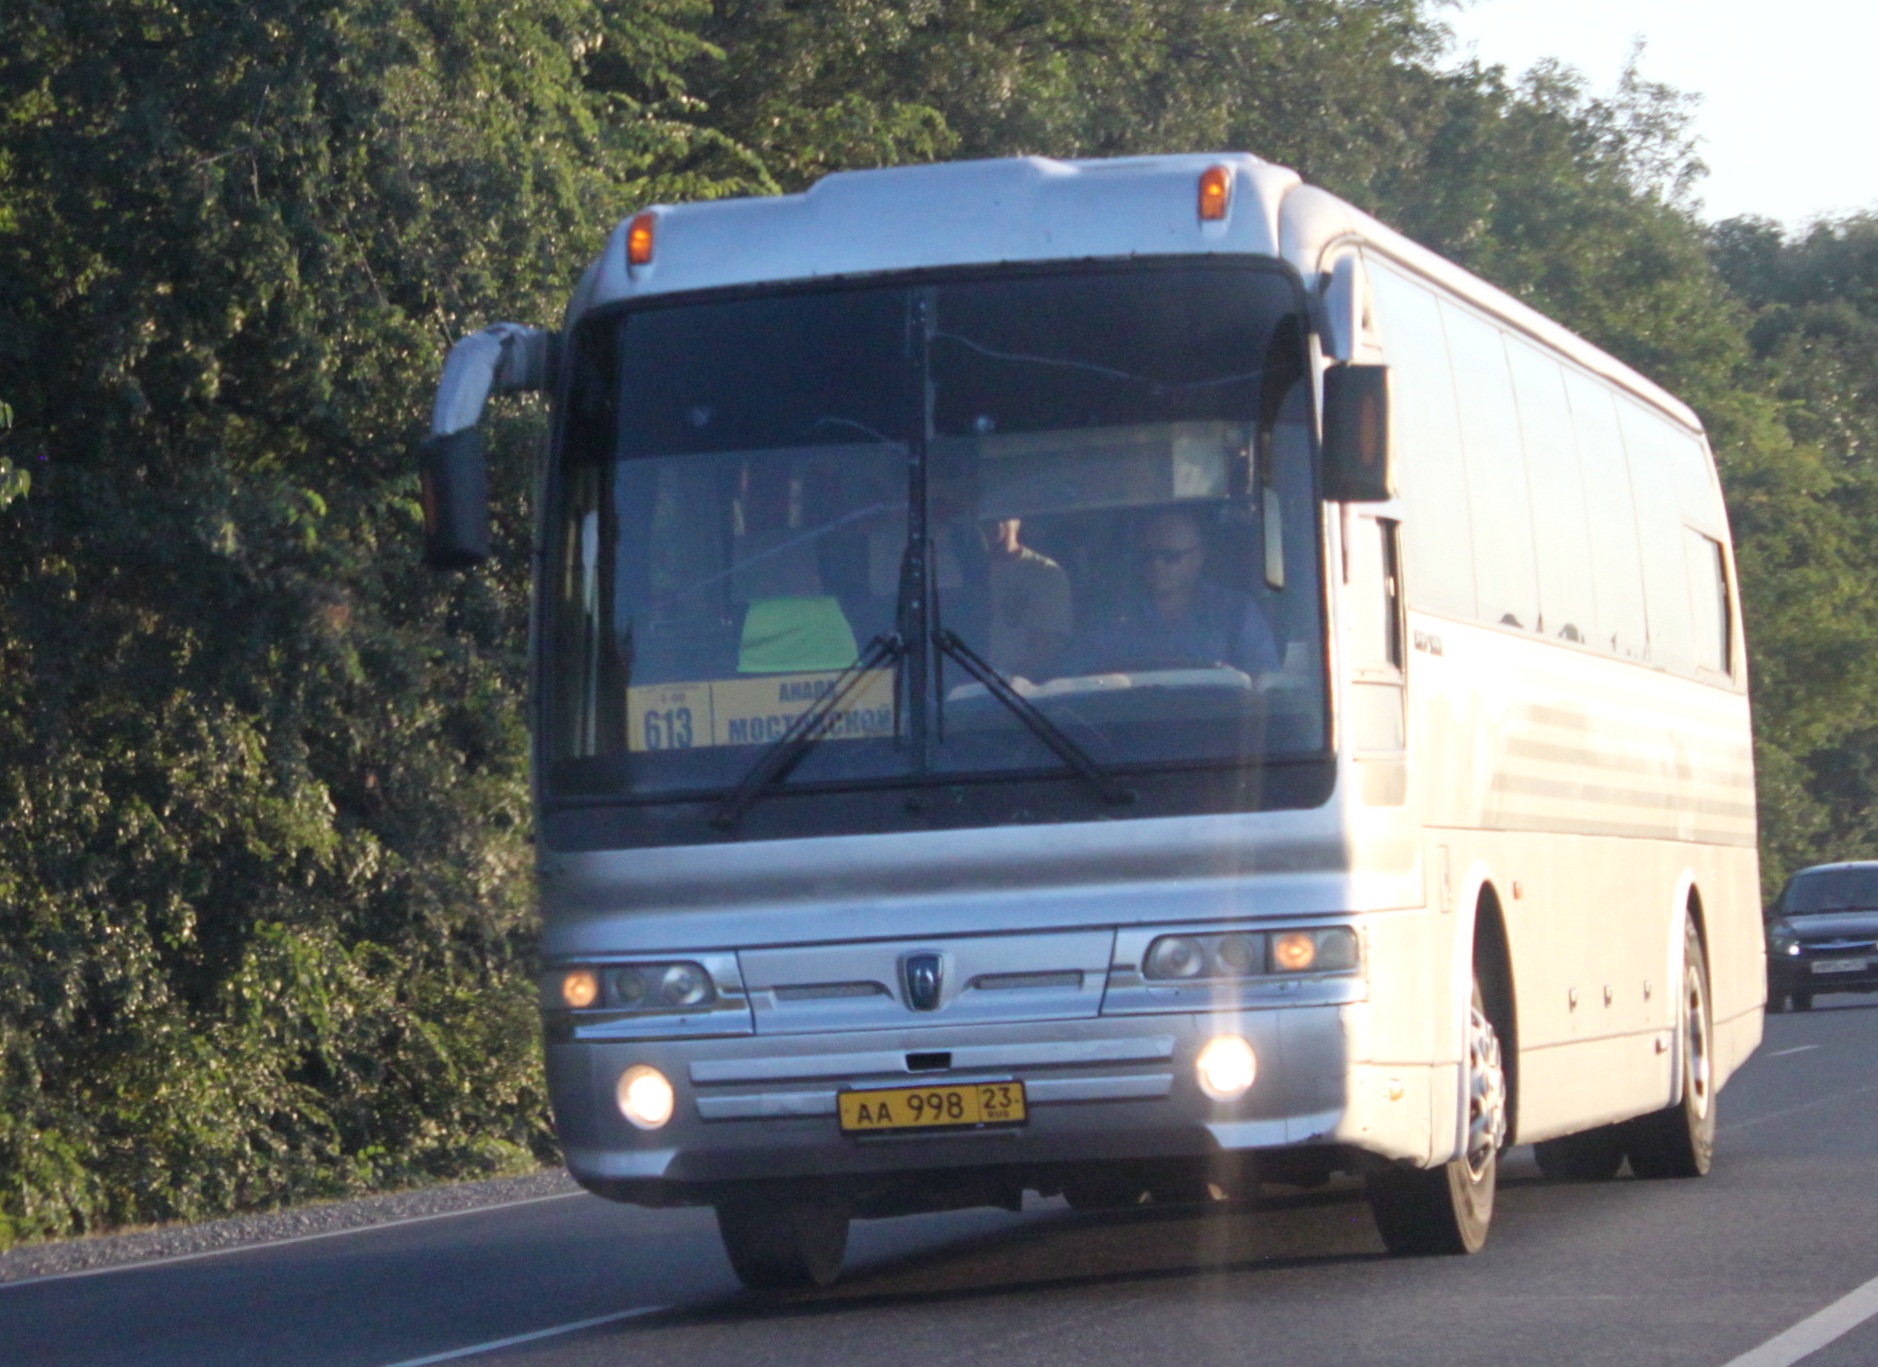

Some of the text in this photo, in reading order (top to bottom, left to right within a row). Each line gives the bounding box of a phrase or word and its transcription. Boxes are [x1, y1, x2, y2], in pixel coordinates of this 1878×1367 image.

[644, 706, 693, 749] 613
[728, 703, 893, 744] МОСТСКОЙ
[906, 1092, 965, 1121] 998
[982, 1087, 1012, 1109] 23
